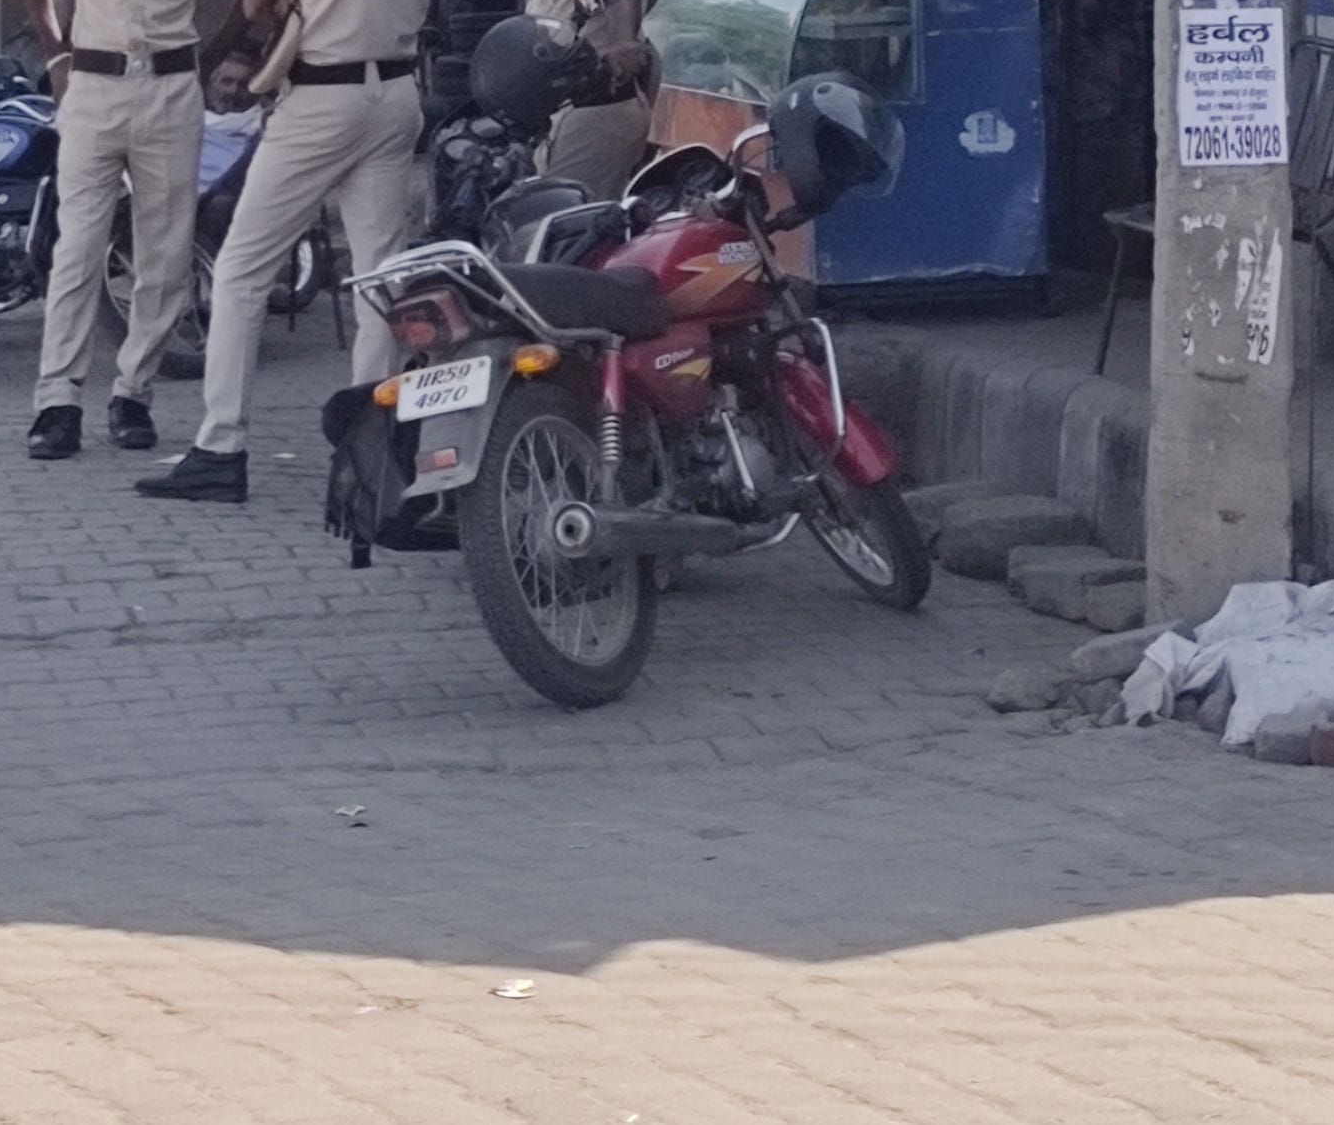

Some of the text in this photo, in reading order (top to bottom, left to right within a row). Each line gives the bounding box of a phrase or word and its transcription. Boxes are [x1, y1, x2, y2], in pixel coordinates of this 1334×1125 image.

[1194, 45, 1264, 63] कम्पनी
[416, 363, 471, 389] HR59
[415, 385, 468, 409] 4970
